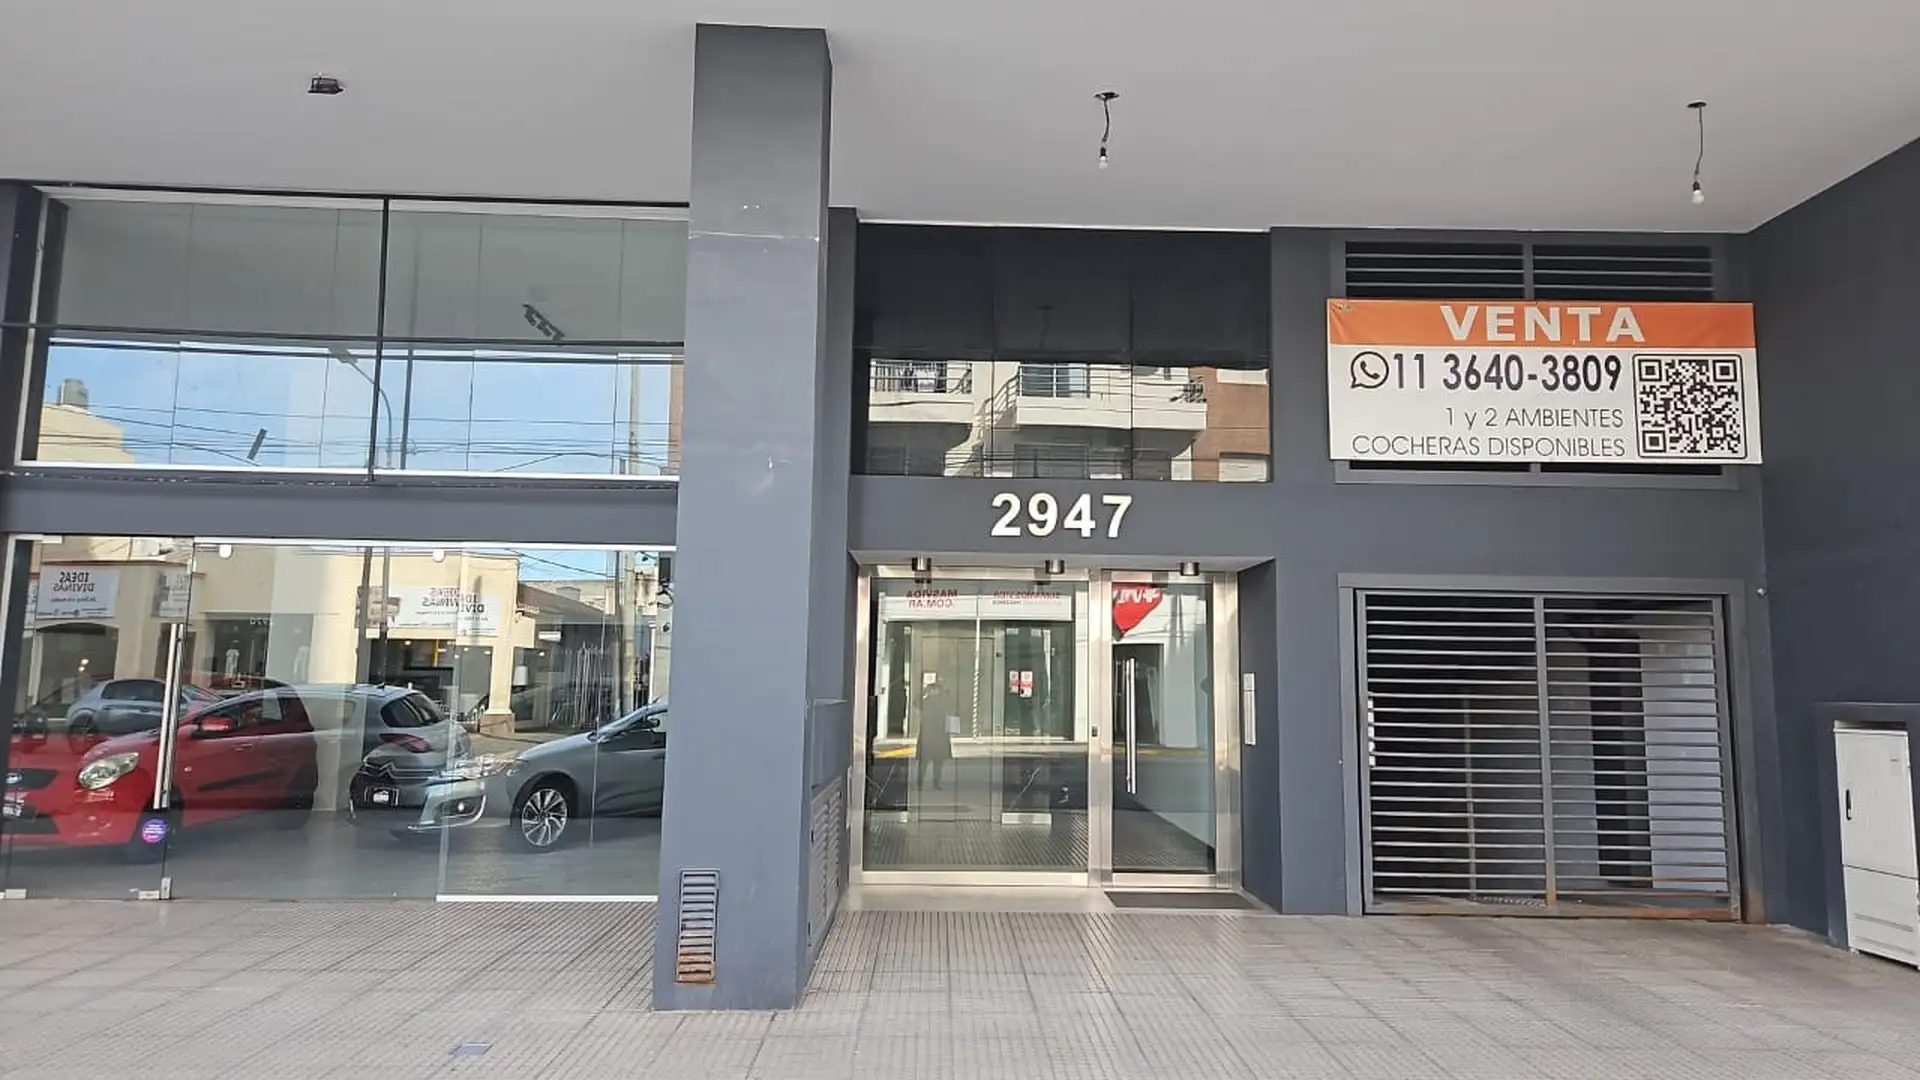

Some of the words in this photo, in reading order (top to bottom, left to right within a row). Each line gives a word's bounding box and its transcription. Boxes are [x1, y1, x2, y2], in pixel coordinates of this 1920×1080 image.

[1440, 305, 1645, 342] VENTA
[1393, 353, 1425, 389] 11
[1442, 354, 1621, 392] 3640-3809
[1446, 407, 1454, 426] 1
[1464, 411, 1477, 430] y
[1484, 407, 1498, 427] 2
[1505, 408, 1624, 428] AMBIENTES
[1351, 435, 1480, 455] COCHERAS
[1488, 436, 1626, 457] DISPONIBLES
[990, 492, 1133, 538] 2947
